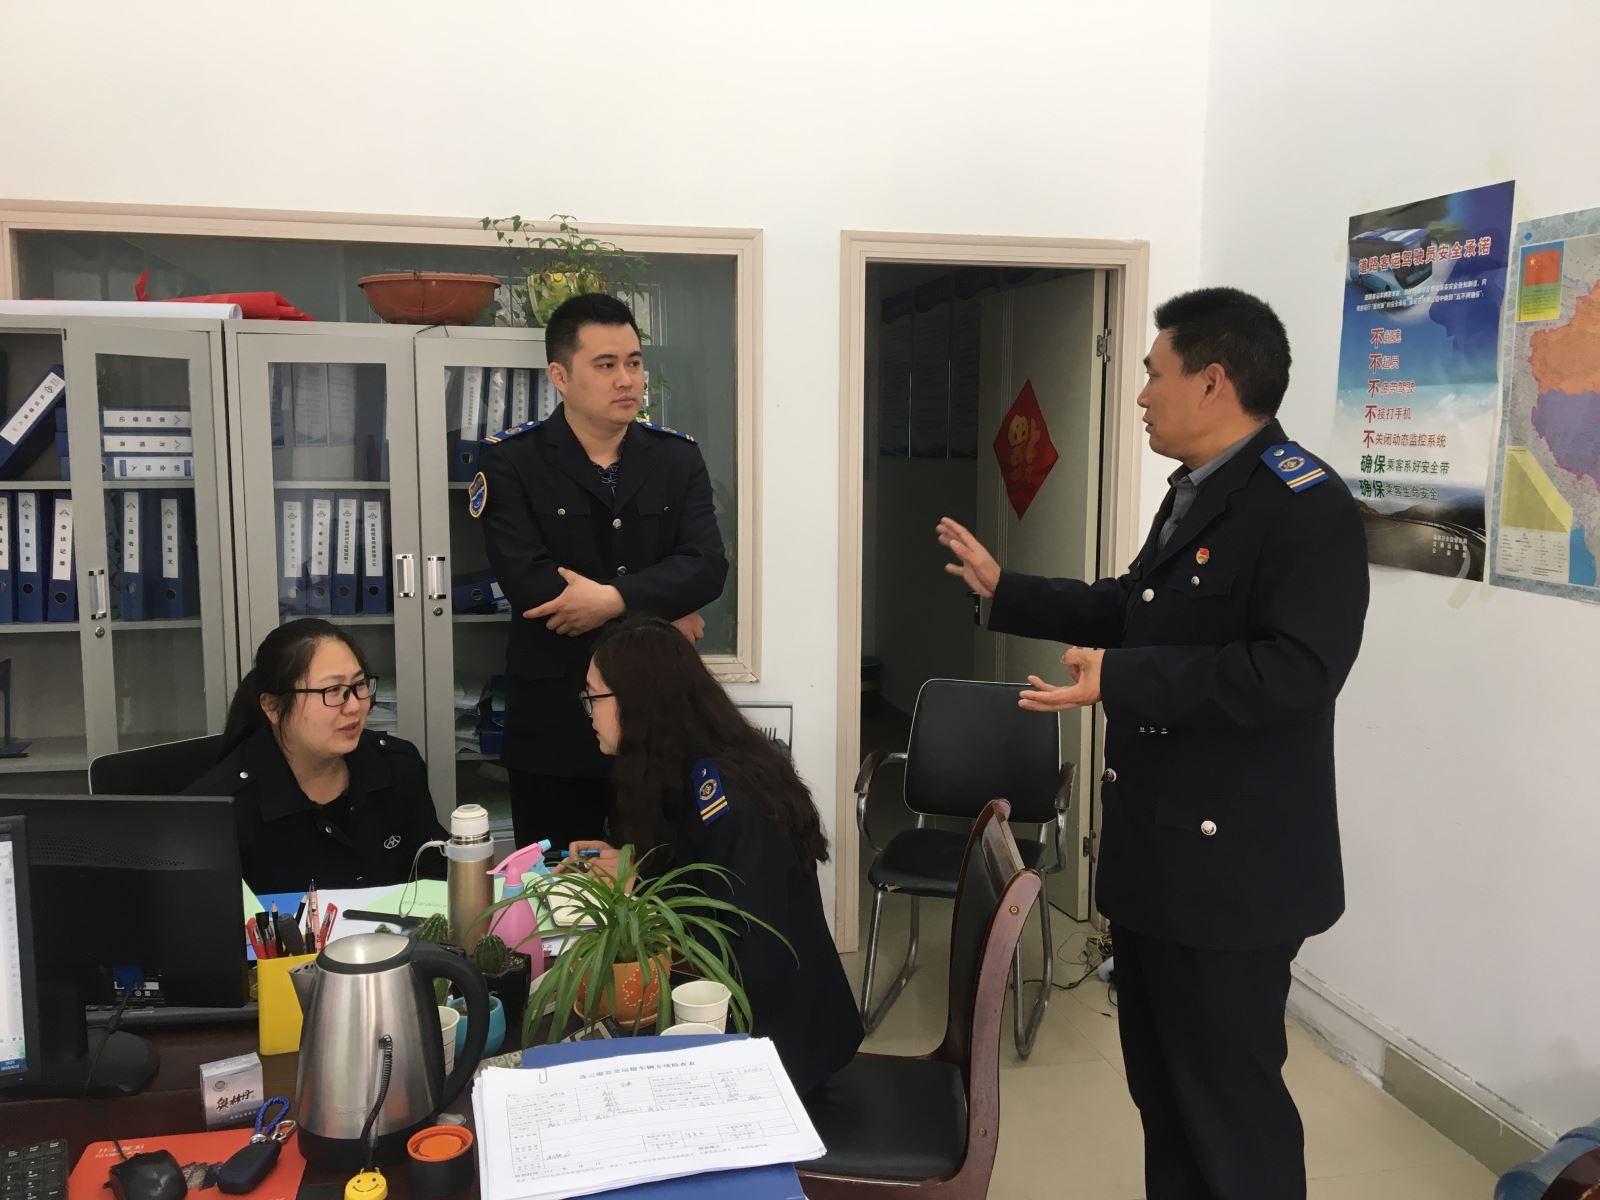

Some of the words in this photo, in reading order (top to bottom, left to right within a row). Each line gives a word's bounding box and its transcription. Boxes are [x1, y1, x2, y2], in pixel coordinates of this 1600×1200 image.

[1358, 236, 1492, 275] 道路客运驾驶员安全承诺
[1364, 405, 1412, 424] 不接打手机
[1363, 430, 1447, 449] 不关闭动态监控系统
[1360, 454, 1451, 476] 确保乘客系好安全带
[1359, 479, 1439, 501] 确保乘客生命安全
